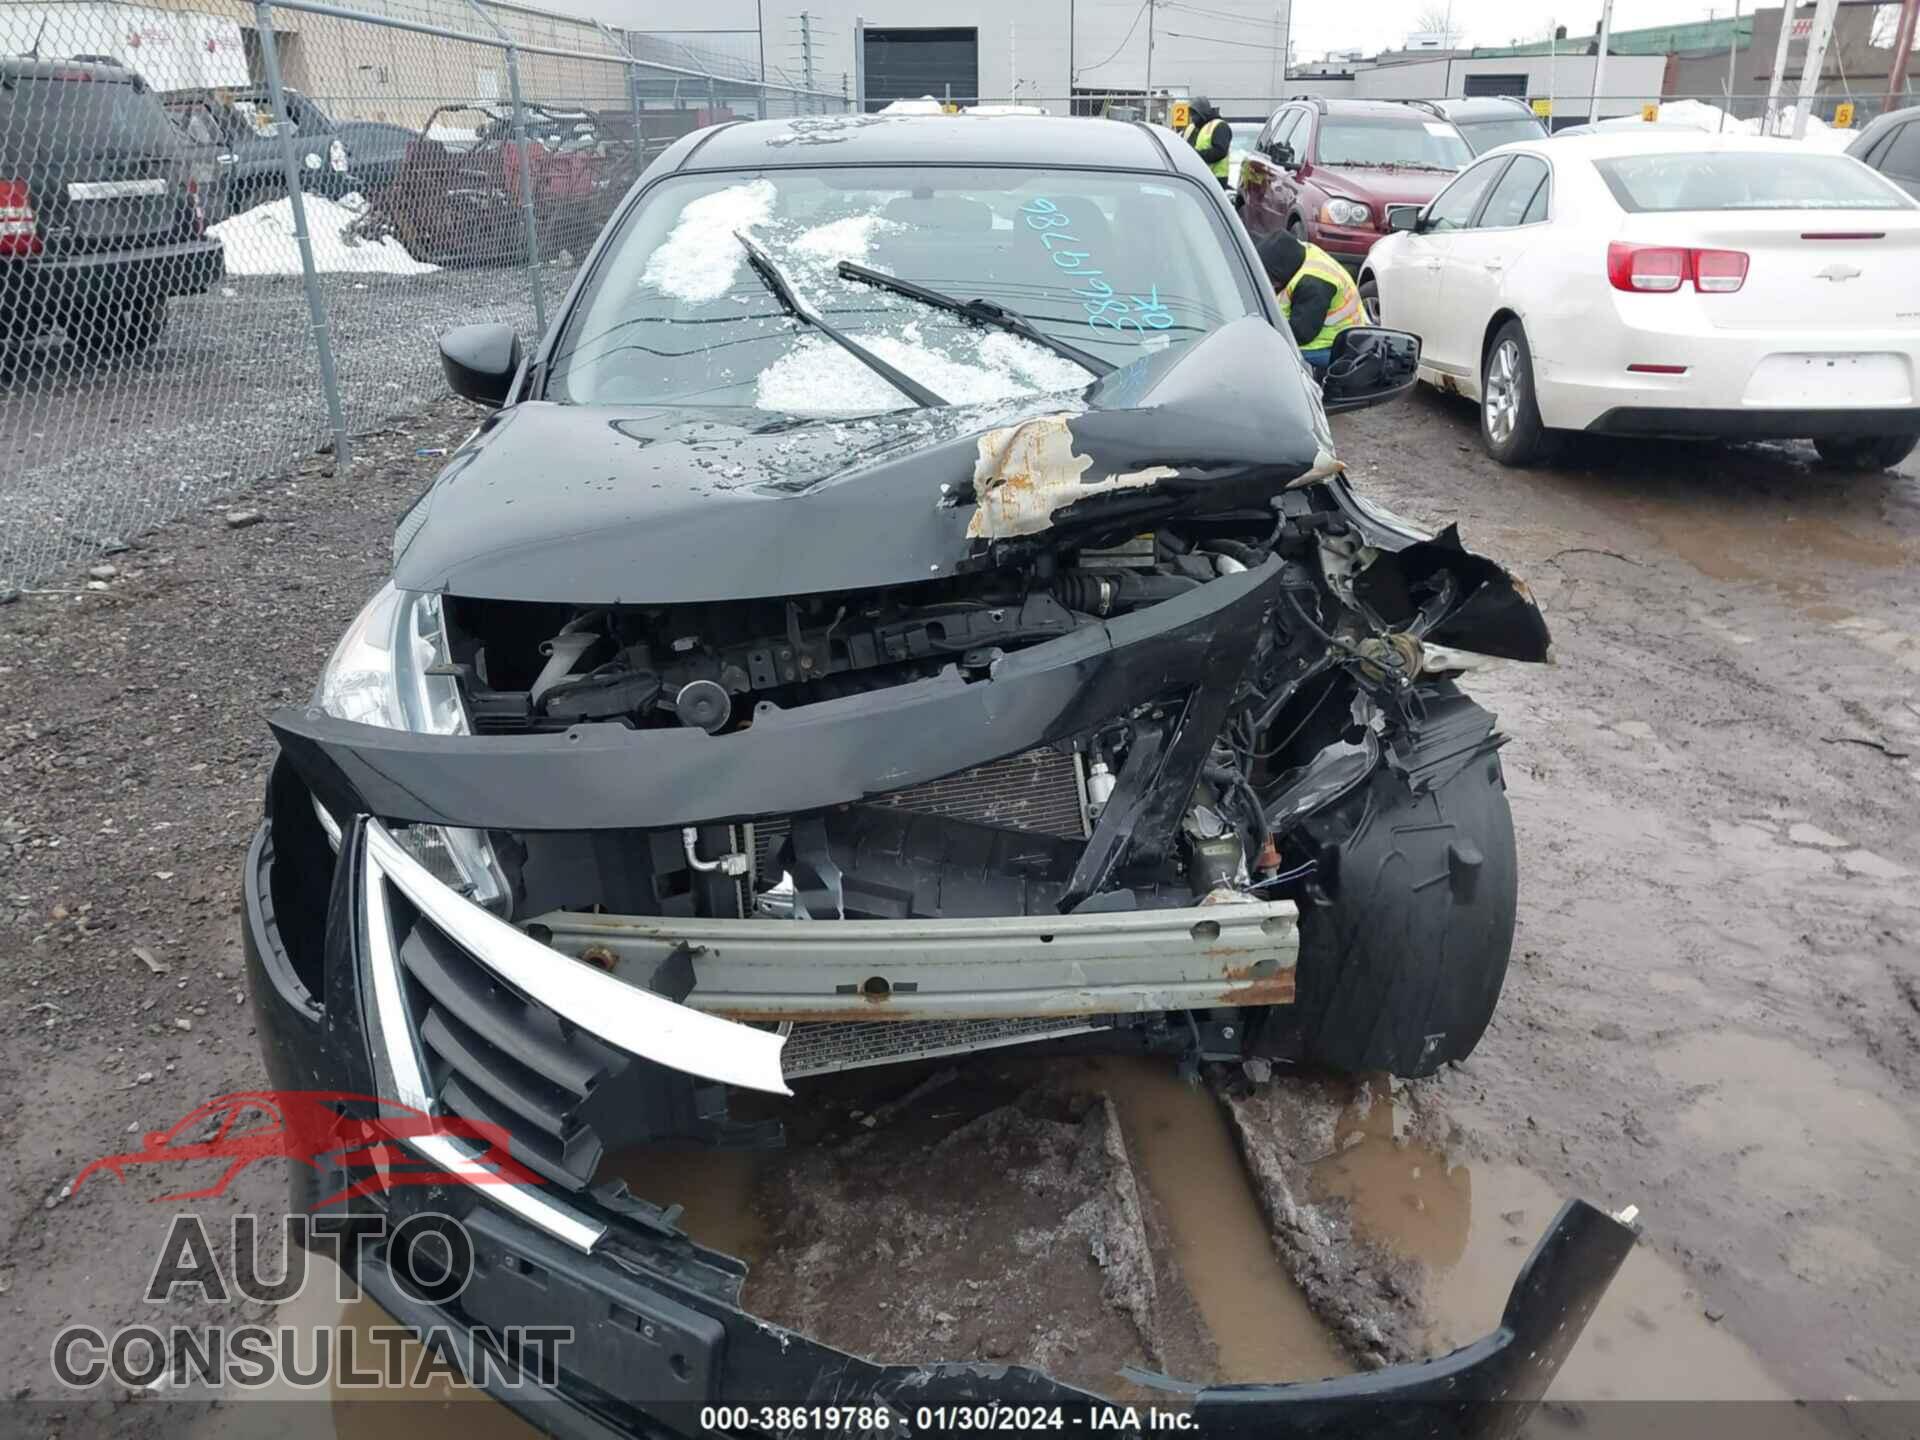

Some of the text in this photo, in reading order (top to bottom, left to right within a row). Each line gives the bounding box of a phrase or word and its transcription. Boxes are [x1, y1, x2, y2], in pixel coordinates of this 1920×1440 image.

[1176, 107, 1185, 122] 2
[1020, 198, 1144, 337] 38619786
[1129, 284, 1174, 329] OK
